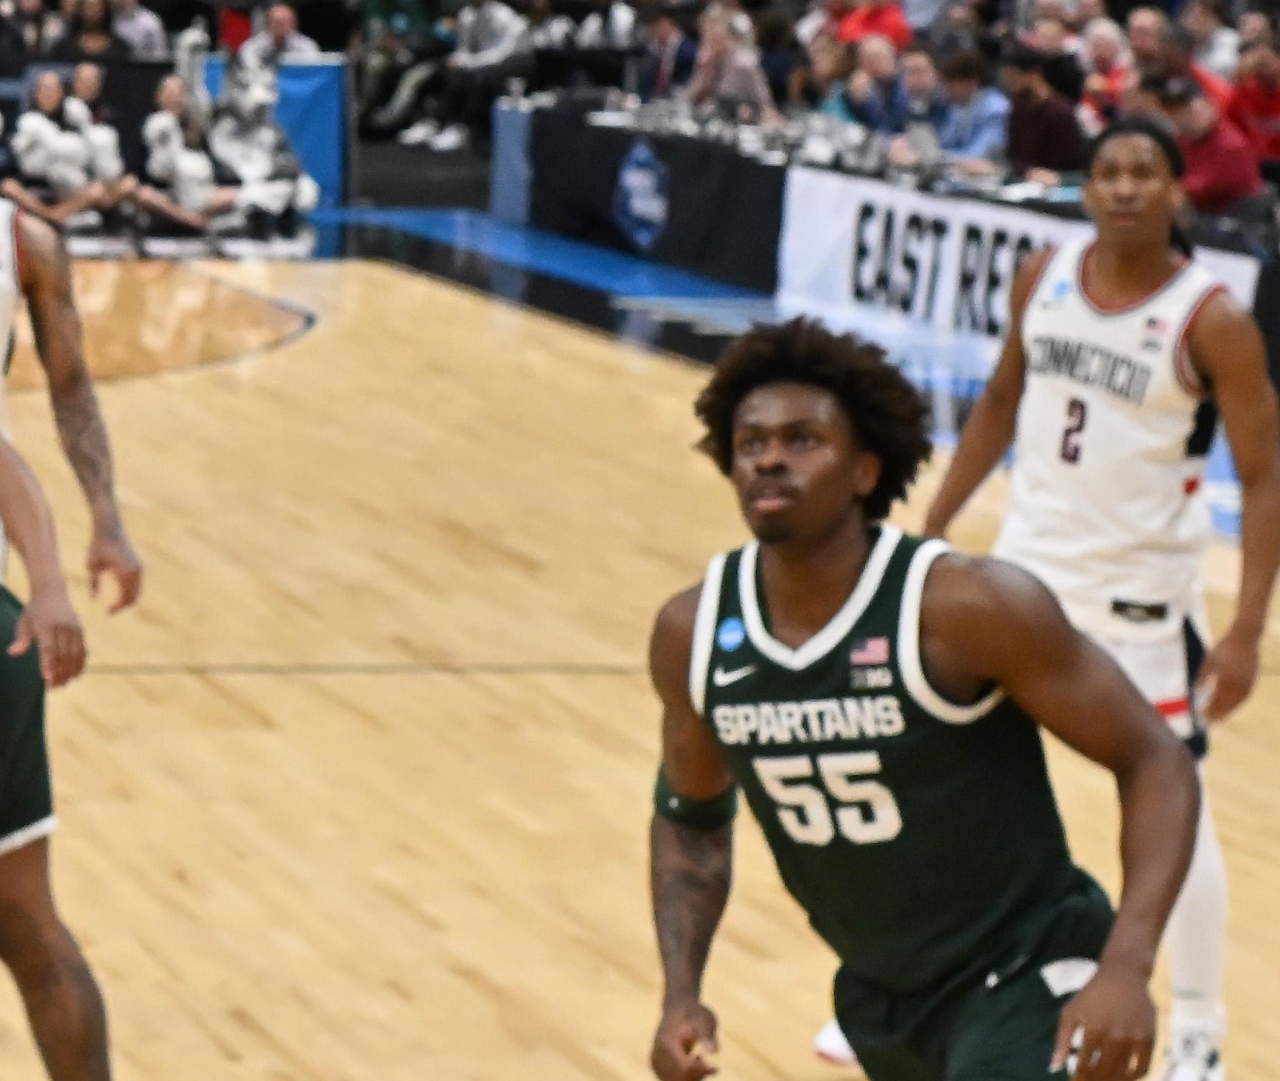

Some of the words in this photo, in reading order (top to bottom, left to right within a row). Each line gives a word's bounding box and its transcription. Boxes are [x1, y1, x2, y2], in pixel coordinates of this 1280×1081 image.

[852, 200, 948, 324] EAST
[1060, 397, 1087, 464] 2
[712, 695, 907, 746] SPARTANS
[751, 750, 903, 847] 55
